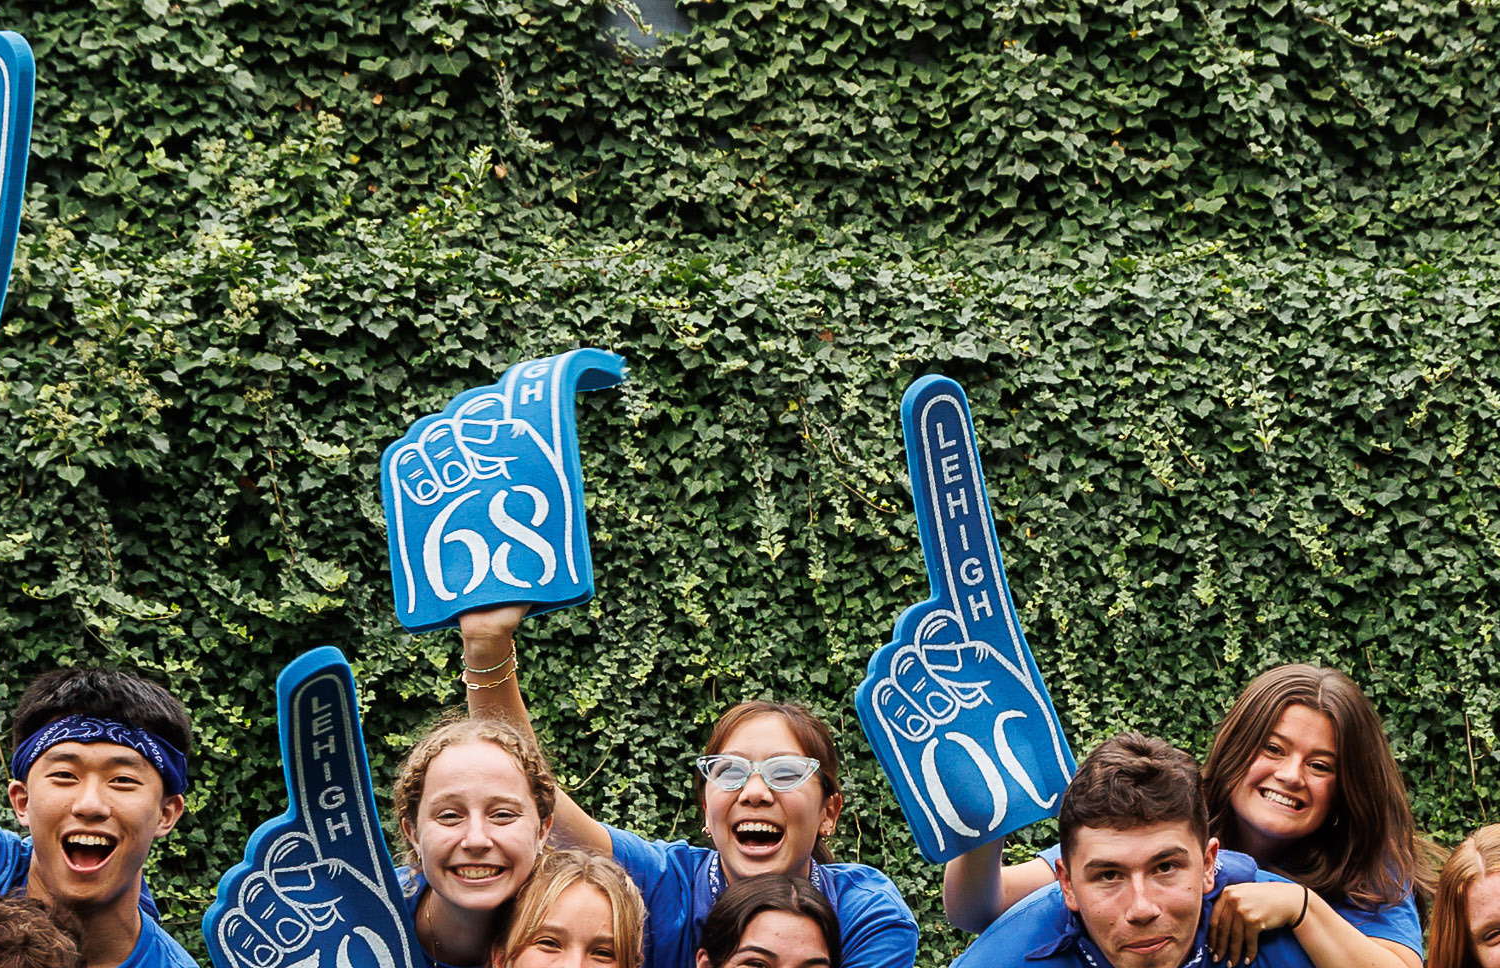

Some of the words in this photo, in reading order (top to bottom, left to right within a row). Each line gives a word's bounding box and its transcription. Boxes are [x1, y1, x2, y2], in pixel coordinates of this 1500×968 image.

[520, 358, 552, 406] GH
[423, 485, 557, 601] 68
[936, 422, 995, 624] LEHIGH
[311, 696, 352, 842] LEHIGH
